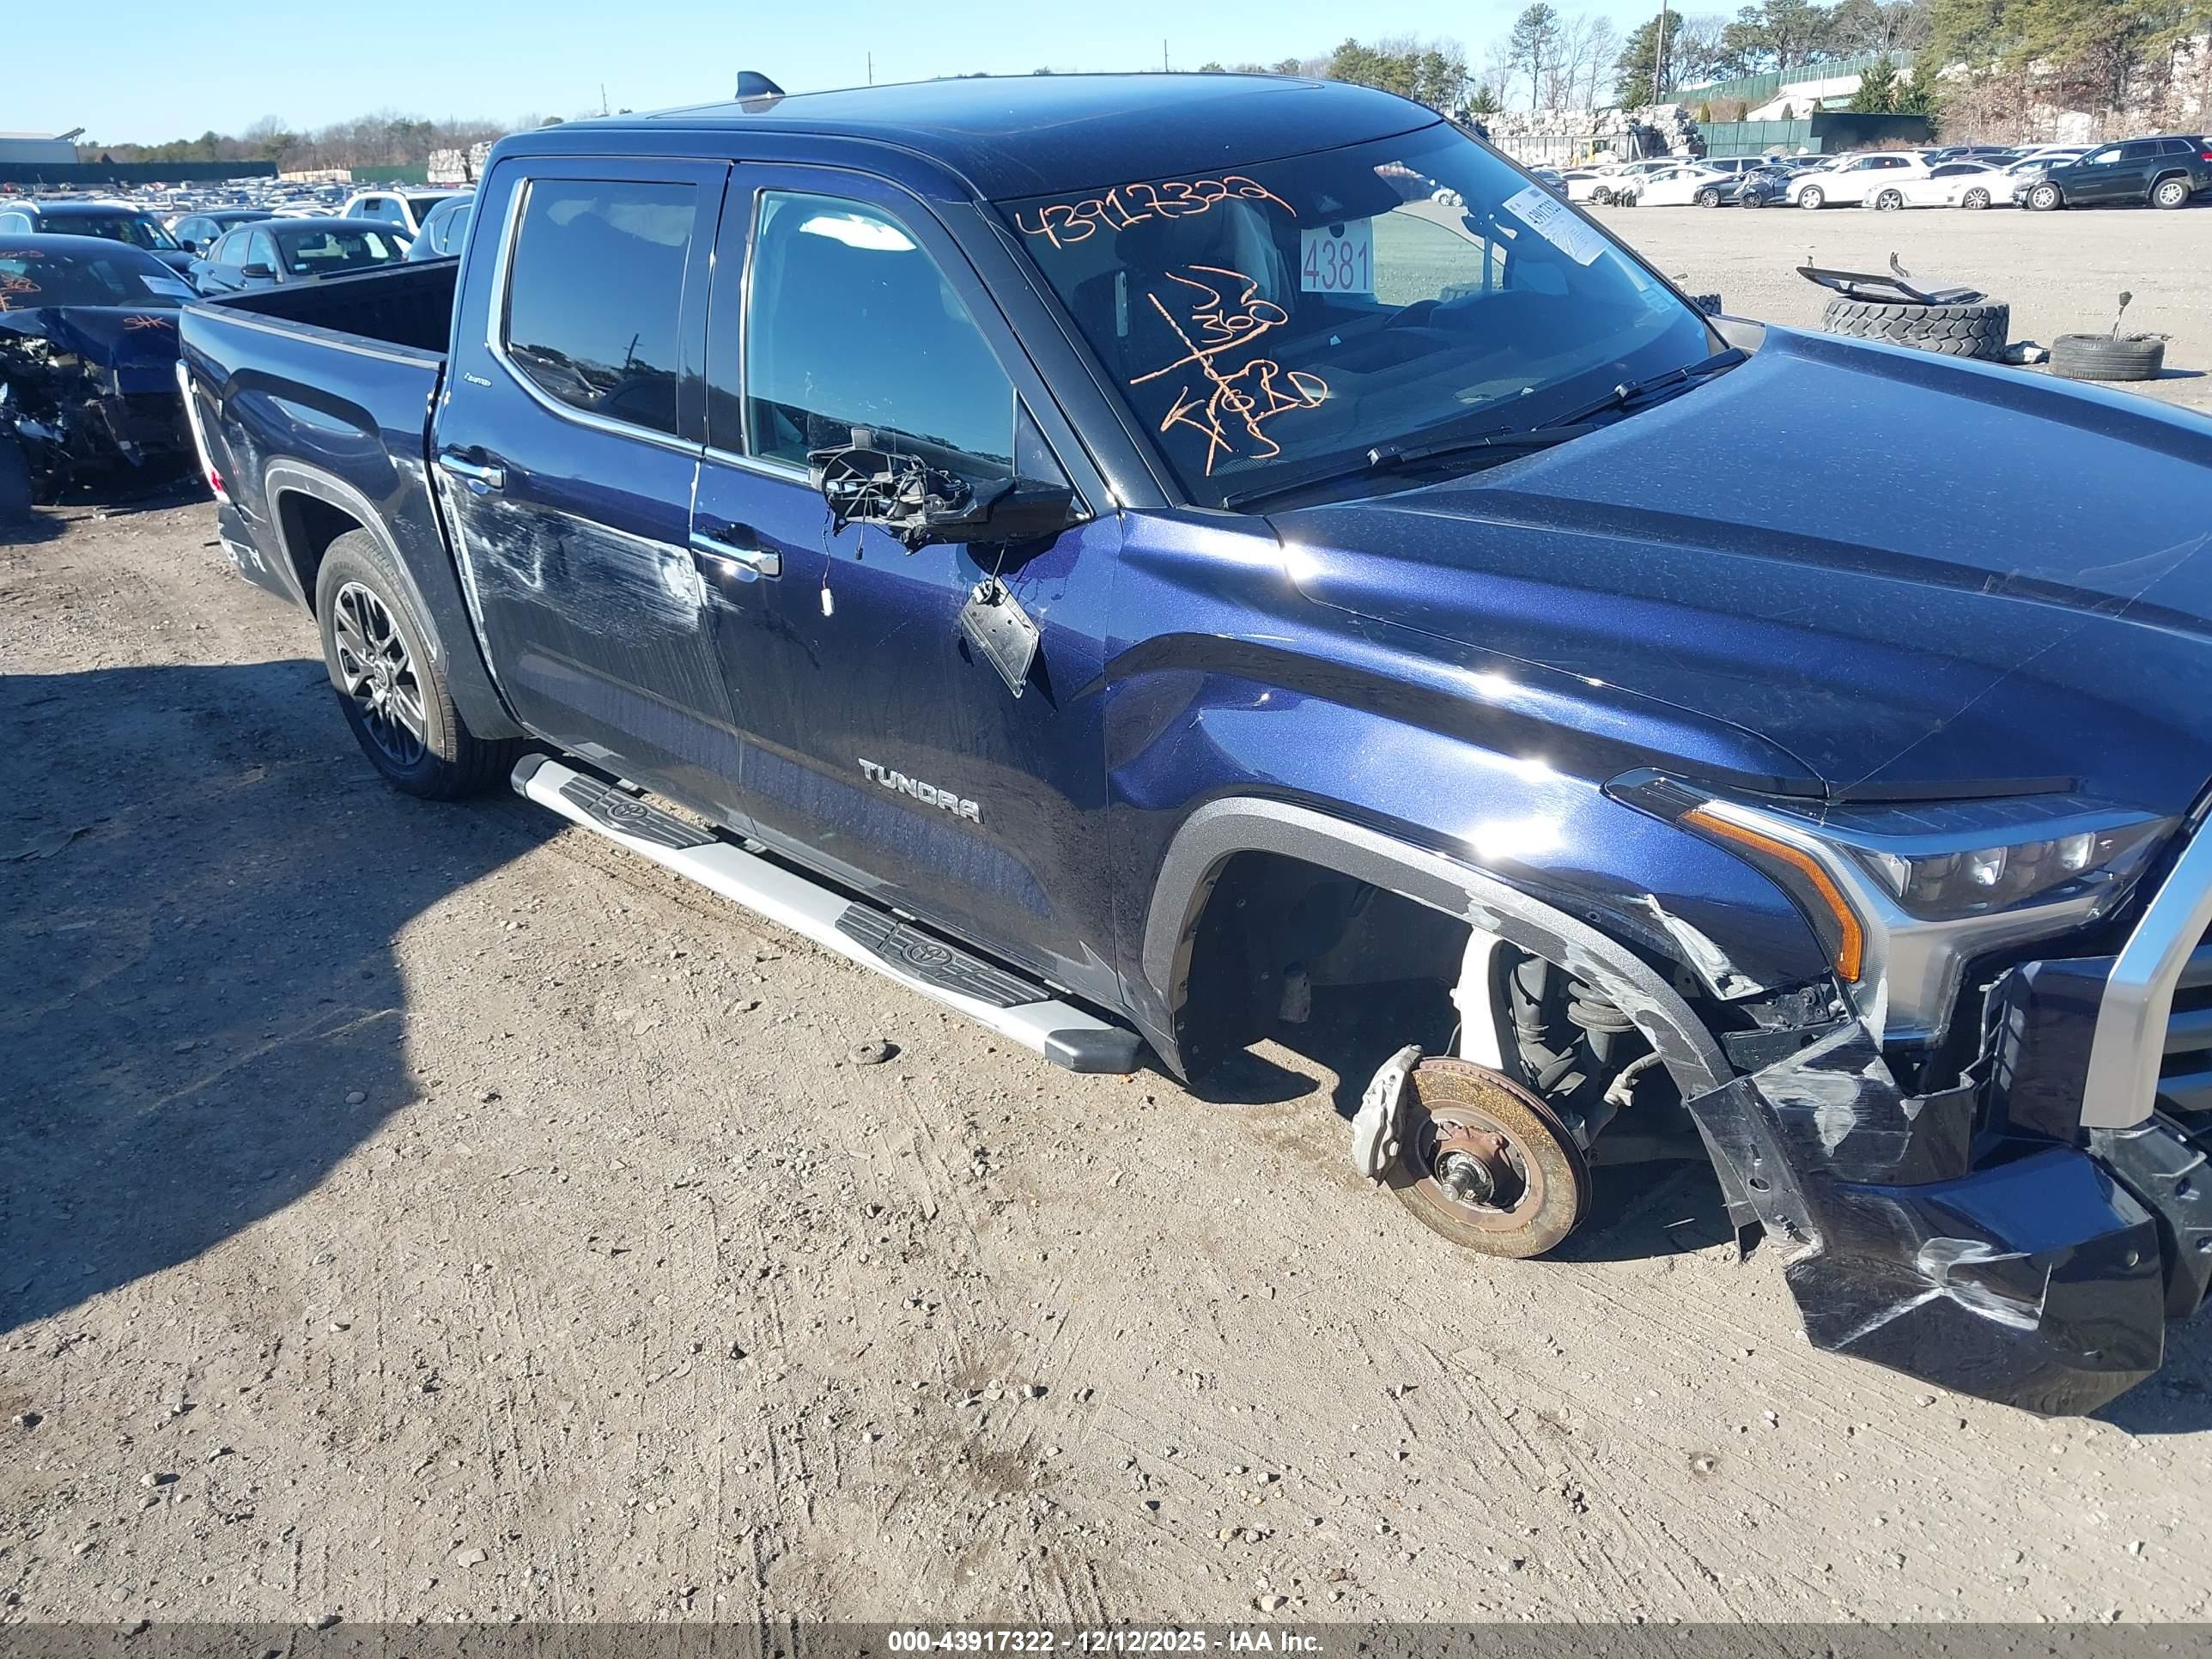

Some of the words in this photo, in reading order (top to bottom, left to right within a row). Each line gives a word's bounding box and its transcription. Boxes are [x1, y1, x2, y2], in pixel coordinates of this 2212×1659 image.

[1015, 176, 1297, 249] 43917322
[1304, 239, 1367, 289] 4381
[858, 757, 981, 824] TUNDRA
